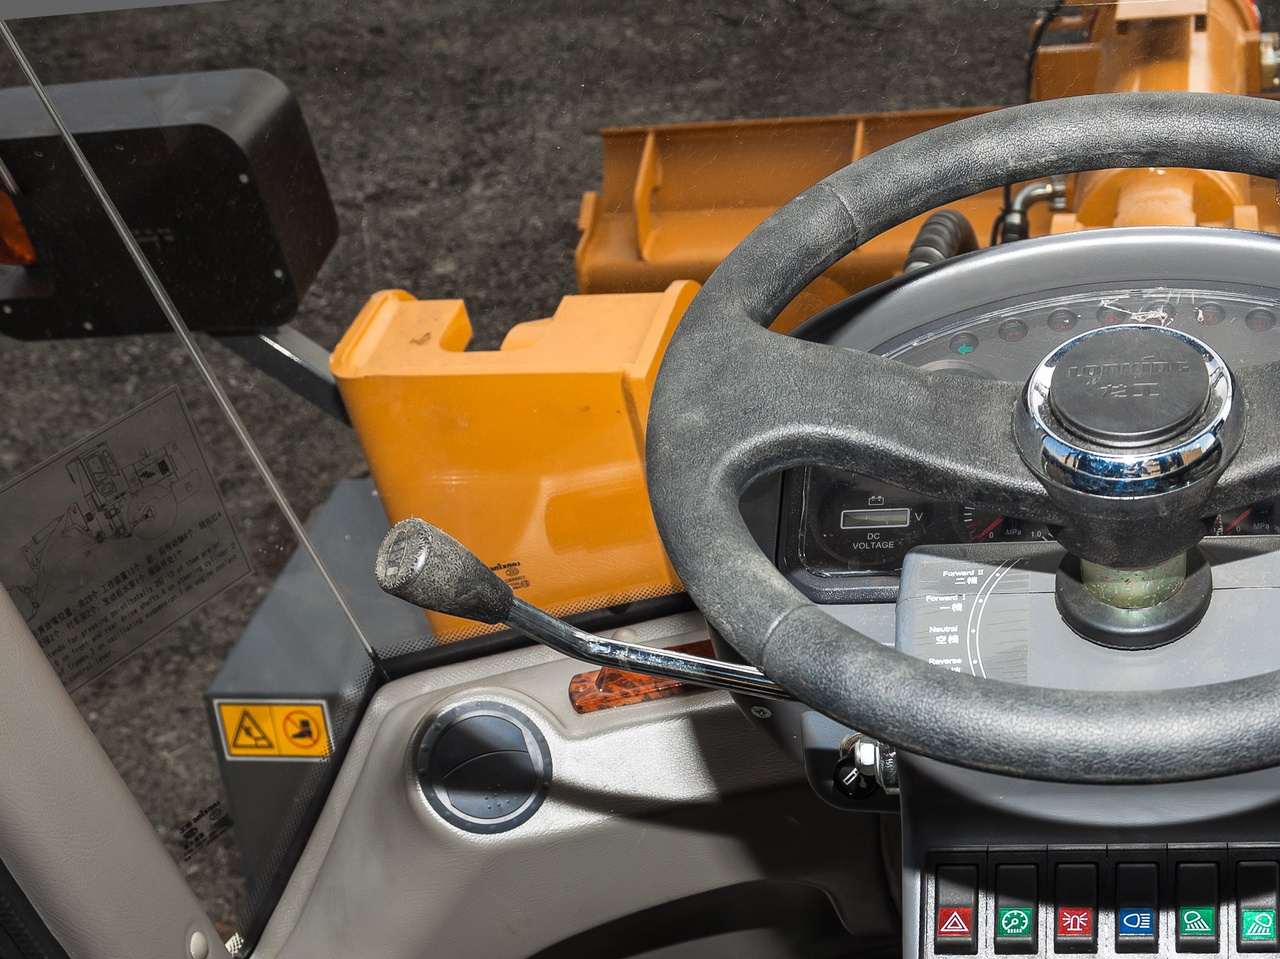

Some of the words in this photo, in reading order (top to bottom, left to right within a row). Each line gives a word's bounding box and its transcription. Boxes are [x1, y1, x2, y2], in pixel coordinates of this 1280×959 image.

[914, 512, 924, 522] V
[867, 532, 881, 541] DC
[852, 541, 894, 550] VOLTAGE
[926, 594, 958, 602] Forward
[929, 625, 958, 633] Neutral
[45, 642, 65, 659] tands
[66, 633, 78, 644] for
[60, 653, 70, 662] on
[70, 639, 90, 655] front
[67, 661, 93, 682] control
